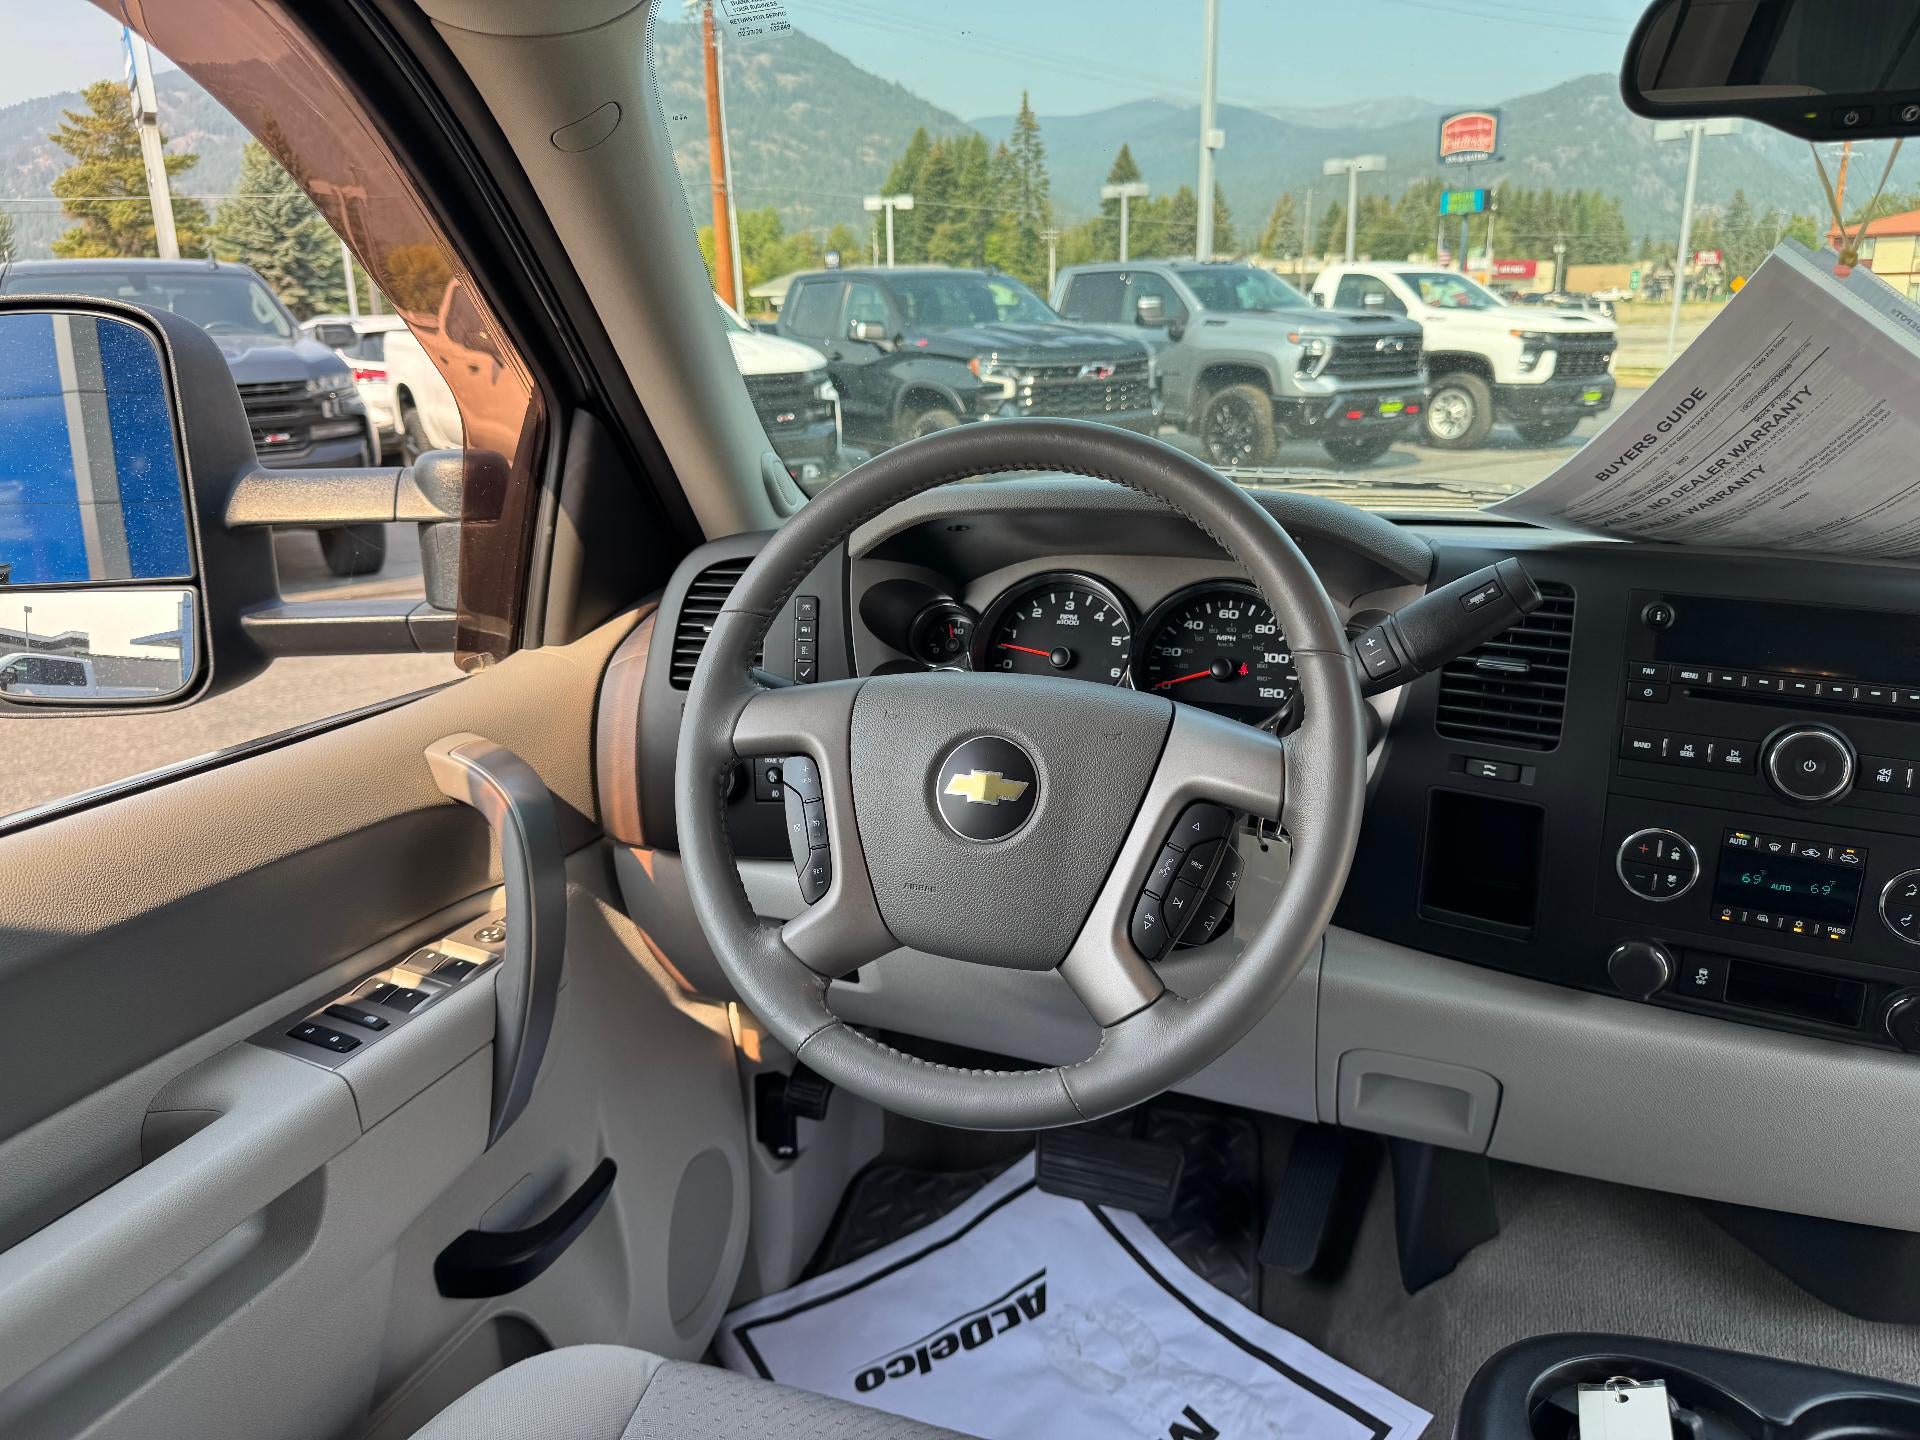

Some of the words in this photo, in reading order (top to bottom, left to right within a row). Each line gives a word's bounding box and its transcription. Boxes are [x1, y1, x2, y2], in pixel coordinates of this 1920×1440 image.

[730, 16, 753, 24] RETURN
[1752, 356, 1766, 369] Keep
[1595, 433, 1658, 482] BUYERS
[1656, 386, 1708, 433] GUIDE
[1647, 497, 1671, 510] NO
[1670, 458, 1731, 498] DEALER
[1728, 384, 1813, 459] WARRANTY
[1682, 464, 1766, 515] WARRANTY
[1065, 601, 1075, 611] 3
[1032, 608, 1042, 618] 2
[1094, 612, 1105, 622] 4
[1218, 609, 1239, 619] 60
[1184, 620, 1204, 630] 40
[1254, 624, 1276, 635] 80
[1012, 629, 1017, 639] 1
[1216, 634, 1236, 642] MPH
[1111, 636, 1122, 646] 5
[1161, 647, 1182, 657] 20
[1263, 652, 1289, 664] 100
[1003, 660, 1013, 669] 0
[1110, 668, 1120, 678] 6
[1642, 667, 1656, 675] FAV
[1680, 671, 1699, 680] MENU
[1258, 687, 1284, 699] 120
[1633, 740, 1652, 749] BAND
[1679, 750, 1695, 758] SEEK
[1725, 755, 1742, 764] SEEK
[1876, 774, 1891, 783] REV
[1729, 836, 1748, 846] AUTO
[1770, 883, 1792, 892] AUTO
[1827, 926, 1846, 935] PASS
[854, 1282, 1047, 1394] ACDelco
